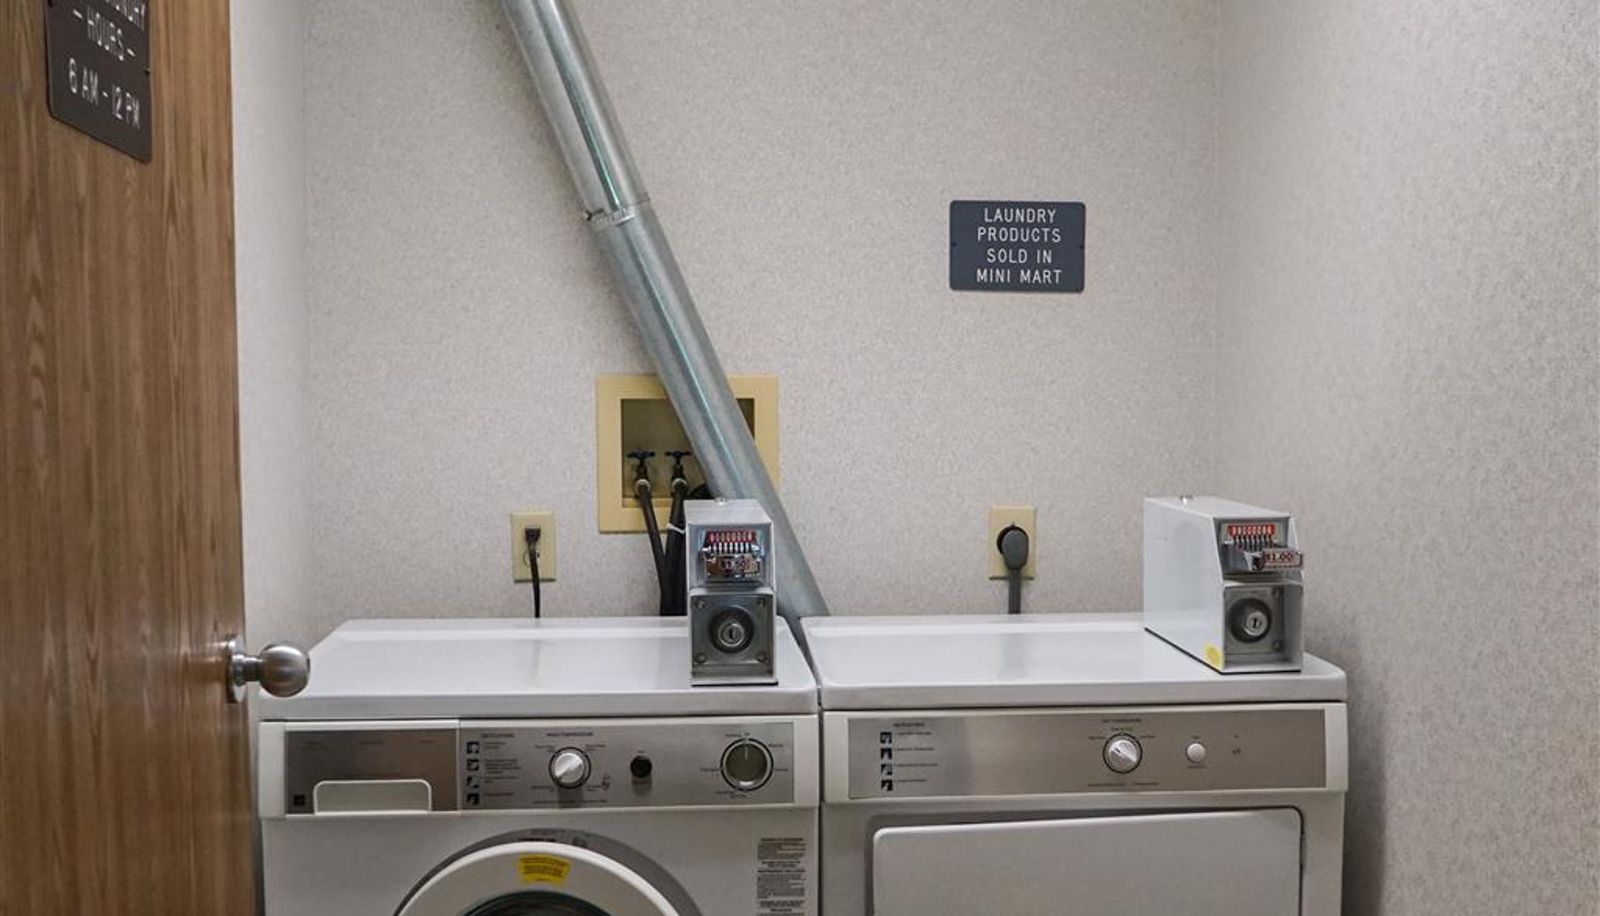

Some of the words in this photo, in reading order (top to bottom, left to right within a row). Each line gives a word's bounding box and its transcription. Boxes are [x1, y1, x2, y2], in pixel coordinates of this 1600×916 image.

[87, 6, 125, 61] HOURS
[69, 57, 78, 94] 6
[81, 66, 99, 106] AM
[112, 84, 123, 120] 12
[126, 92, 140, 130] PM
[984, 207, 1056, 224] LAUNDRY
[977, 226, 1062, 243] PRODUCTS
[986, 248, 1028, 264] SOLD
[1037, 249, 1053, 264] IN
[976, 268, 1011, 284] MINI
[1020, 269, 1062, 284] MART
